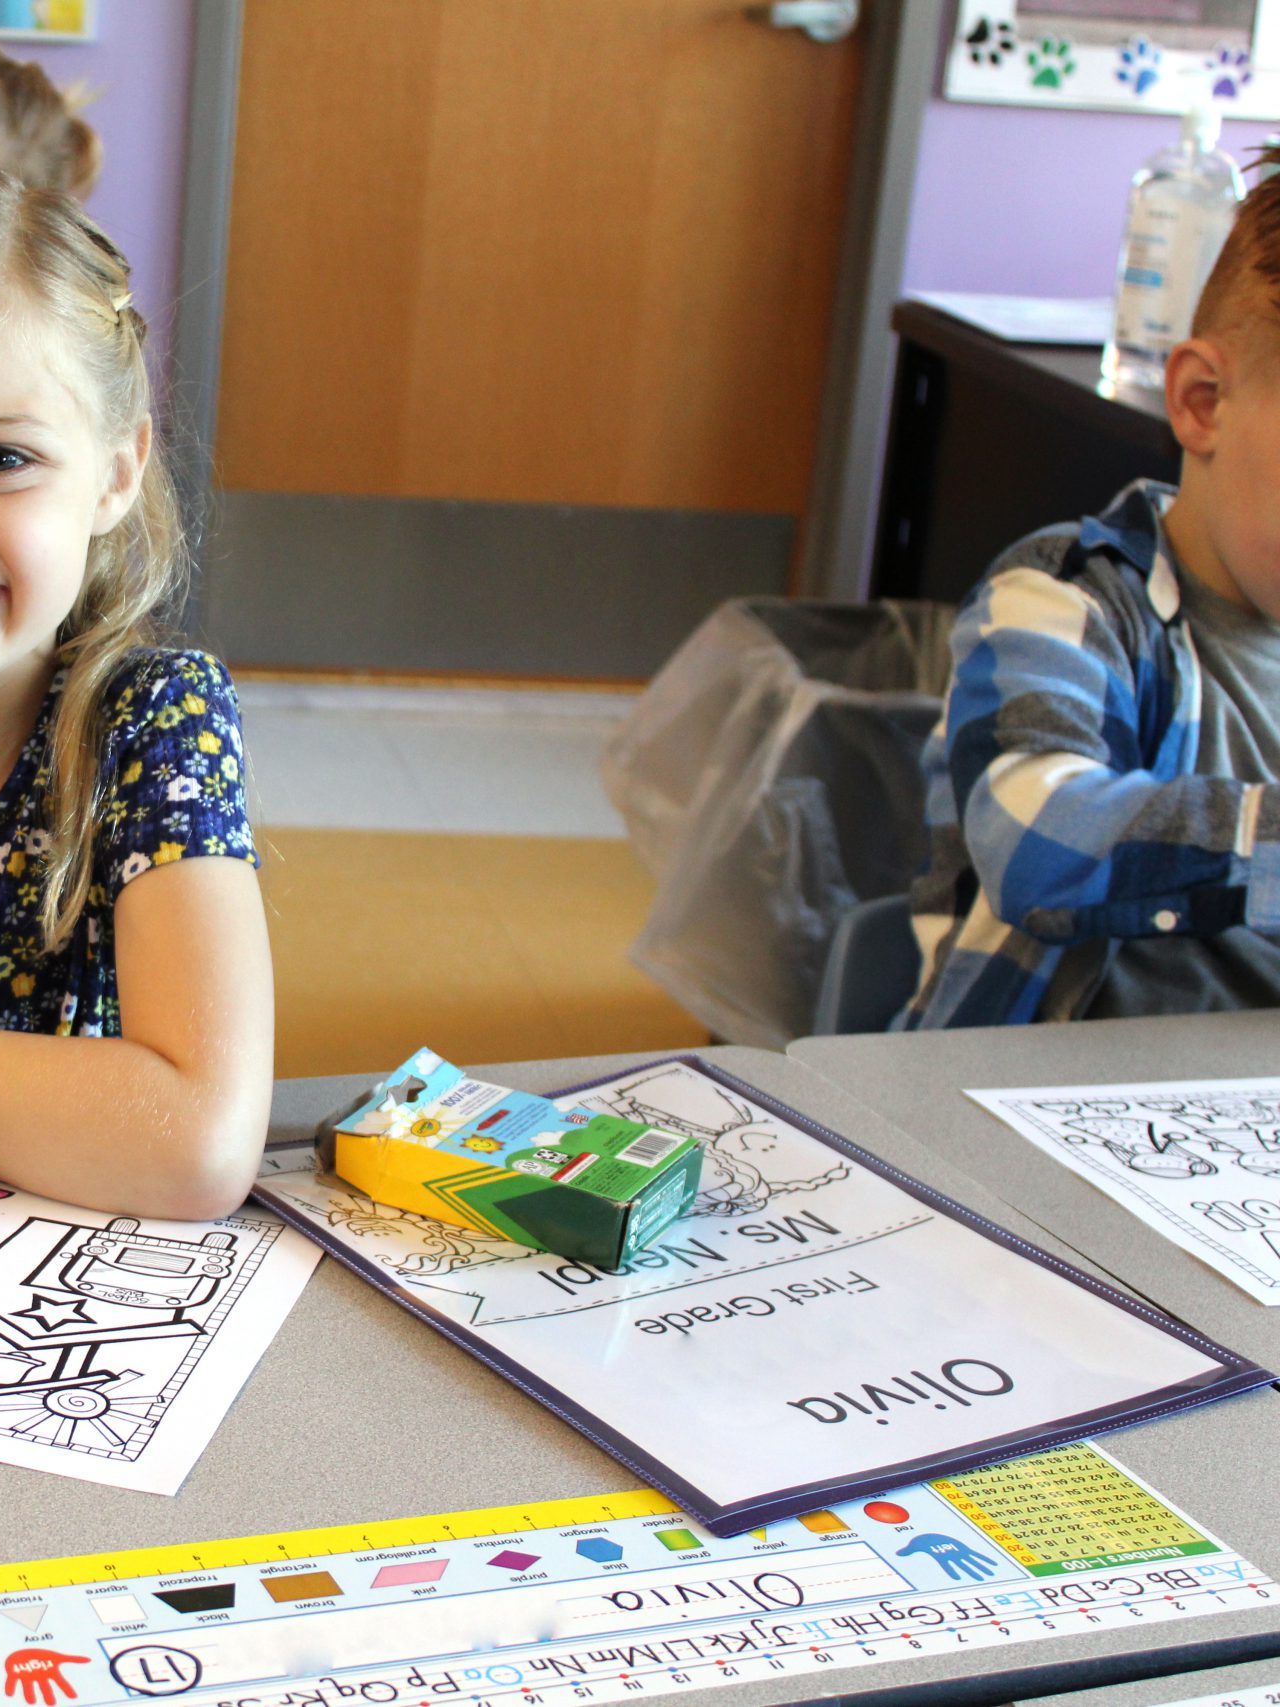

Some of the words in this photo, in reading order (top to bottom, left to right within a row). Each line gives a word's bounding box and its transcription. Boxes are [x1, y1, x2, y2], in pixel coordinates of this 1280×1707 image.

[213, 1222, 262, 1233] Name
[718, 1209, 841, 1245] Ms.
[114, 1288, 144, 1297] BUS
[771, 1270, 880, 1307] First
[97, 1290, 150, 1305] SCHOOL
[633, 1295, 776, 1336] Grade
[786, 1358, 1014, 1426] Olivia
[641, 1516, 683, 1528] cylinder
[1120, 1516, 1138, 1524] 23
[558, 1526, 609, 1538] hexagon
[894, 1524, 914, 1533] red
[1051, 1526, 1066, 1534] 27
[819, 1531, 858, 1543] orange
[1012, 1531, 1030, 1539] 29
[1081, 1534, 1095, 1542] 16
[472, 1537, 525, 1550] rhombus
[752, 1540, 788, 1553] yellow
[930, 1542, 959, 1555] left
[1007, 1544, 1023, 1552] 20
[1026, 1542, 1041, 1550] 19
[355, 1547, 437, 1564] parallelogram
[676, 1550, 712, 1562] green
[1020, 1555, 1036, 1563] 10
[1059, 1550, 1070, 1558] 8
[1106, 1546, 1184, 1564] Numbers
[259, 1562, 318, 1576] rectangle
[602, 1562, 628, 1572] blue
[1060, 1556, 1108, 1571] 1-100
[1196, 1560, 1245, 1581] Aa
[158, 1574, 218, 1588] trapezoid
[510, 1572, 548, 1583] purple
[1146, 1568, 1200, 1590] Bb
[84, 1584, 130, 1596] square
[410, 1586, 437, 1597] pink
[1092, 1577, 1144, 1597] Cc
[601, 1573, 804, 1619] Olivia
[1039, 1583, 1095, 1608] Dd
[1216, 1595, 1227, 1604] 1
[1256, 1589, 1270, 1598] 0
[294, 1599, 336, 1610] brown
[993, 1591, 1045, 1612] Ee
[1173, 1601, 1186, 1611] 2
[879, 1601, 945, 1625] Gg
[951, 1598, 995, 1621] Ff
[1129, 1608, 1142, 1617] 3
[195, 1612, 230, 1624] black
[831, 1612, 888, 1635] Hh
[1086, 1614, 1101, 1623] 4
[110, 1622, 148, 1634] white
[801, 1620, 830, 1640] Ii
[998, 1626, 1010, 1636] 6
[1042, 1620, 1056, 1630] 5
[24, 1632, 54, 1644] gray
[750, 1618, 797, 1647] Jj
[956, 1633, 968, 1642] 7
[703, 1631, 758, 1654] Kk
[908, 1639, 922, 1649] 8
[587, 1644, 662, 1668] Mm
[662, 1640, 704, 1662] Ll
[861, 1647, 876, 1656] 9
[814, 1652, 834, 1663] 10
[12, 1658, 54, 1674] right
[139, 1655, 187, 1684] 17
[527, 1654, 587, 1677] Nn
[768, 1660, 785, 1670] 11
[464, 1665, 523, 1687] Oo
[670, 1672, 691, 1683] 13
[720, 1666, 740, 1677] 12
[407, 1666, 460, 1693] Pp
[623, 1680, 643, 1690] 14
[319, 1677, 399, 1703] Qq
[572, 1686, 594, 1698] 15
[523, 1694, 544, 1705] 16
